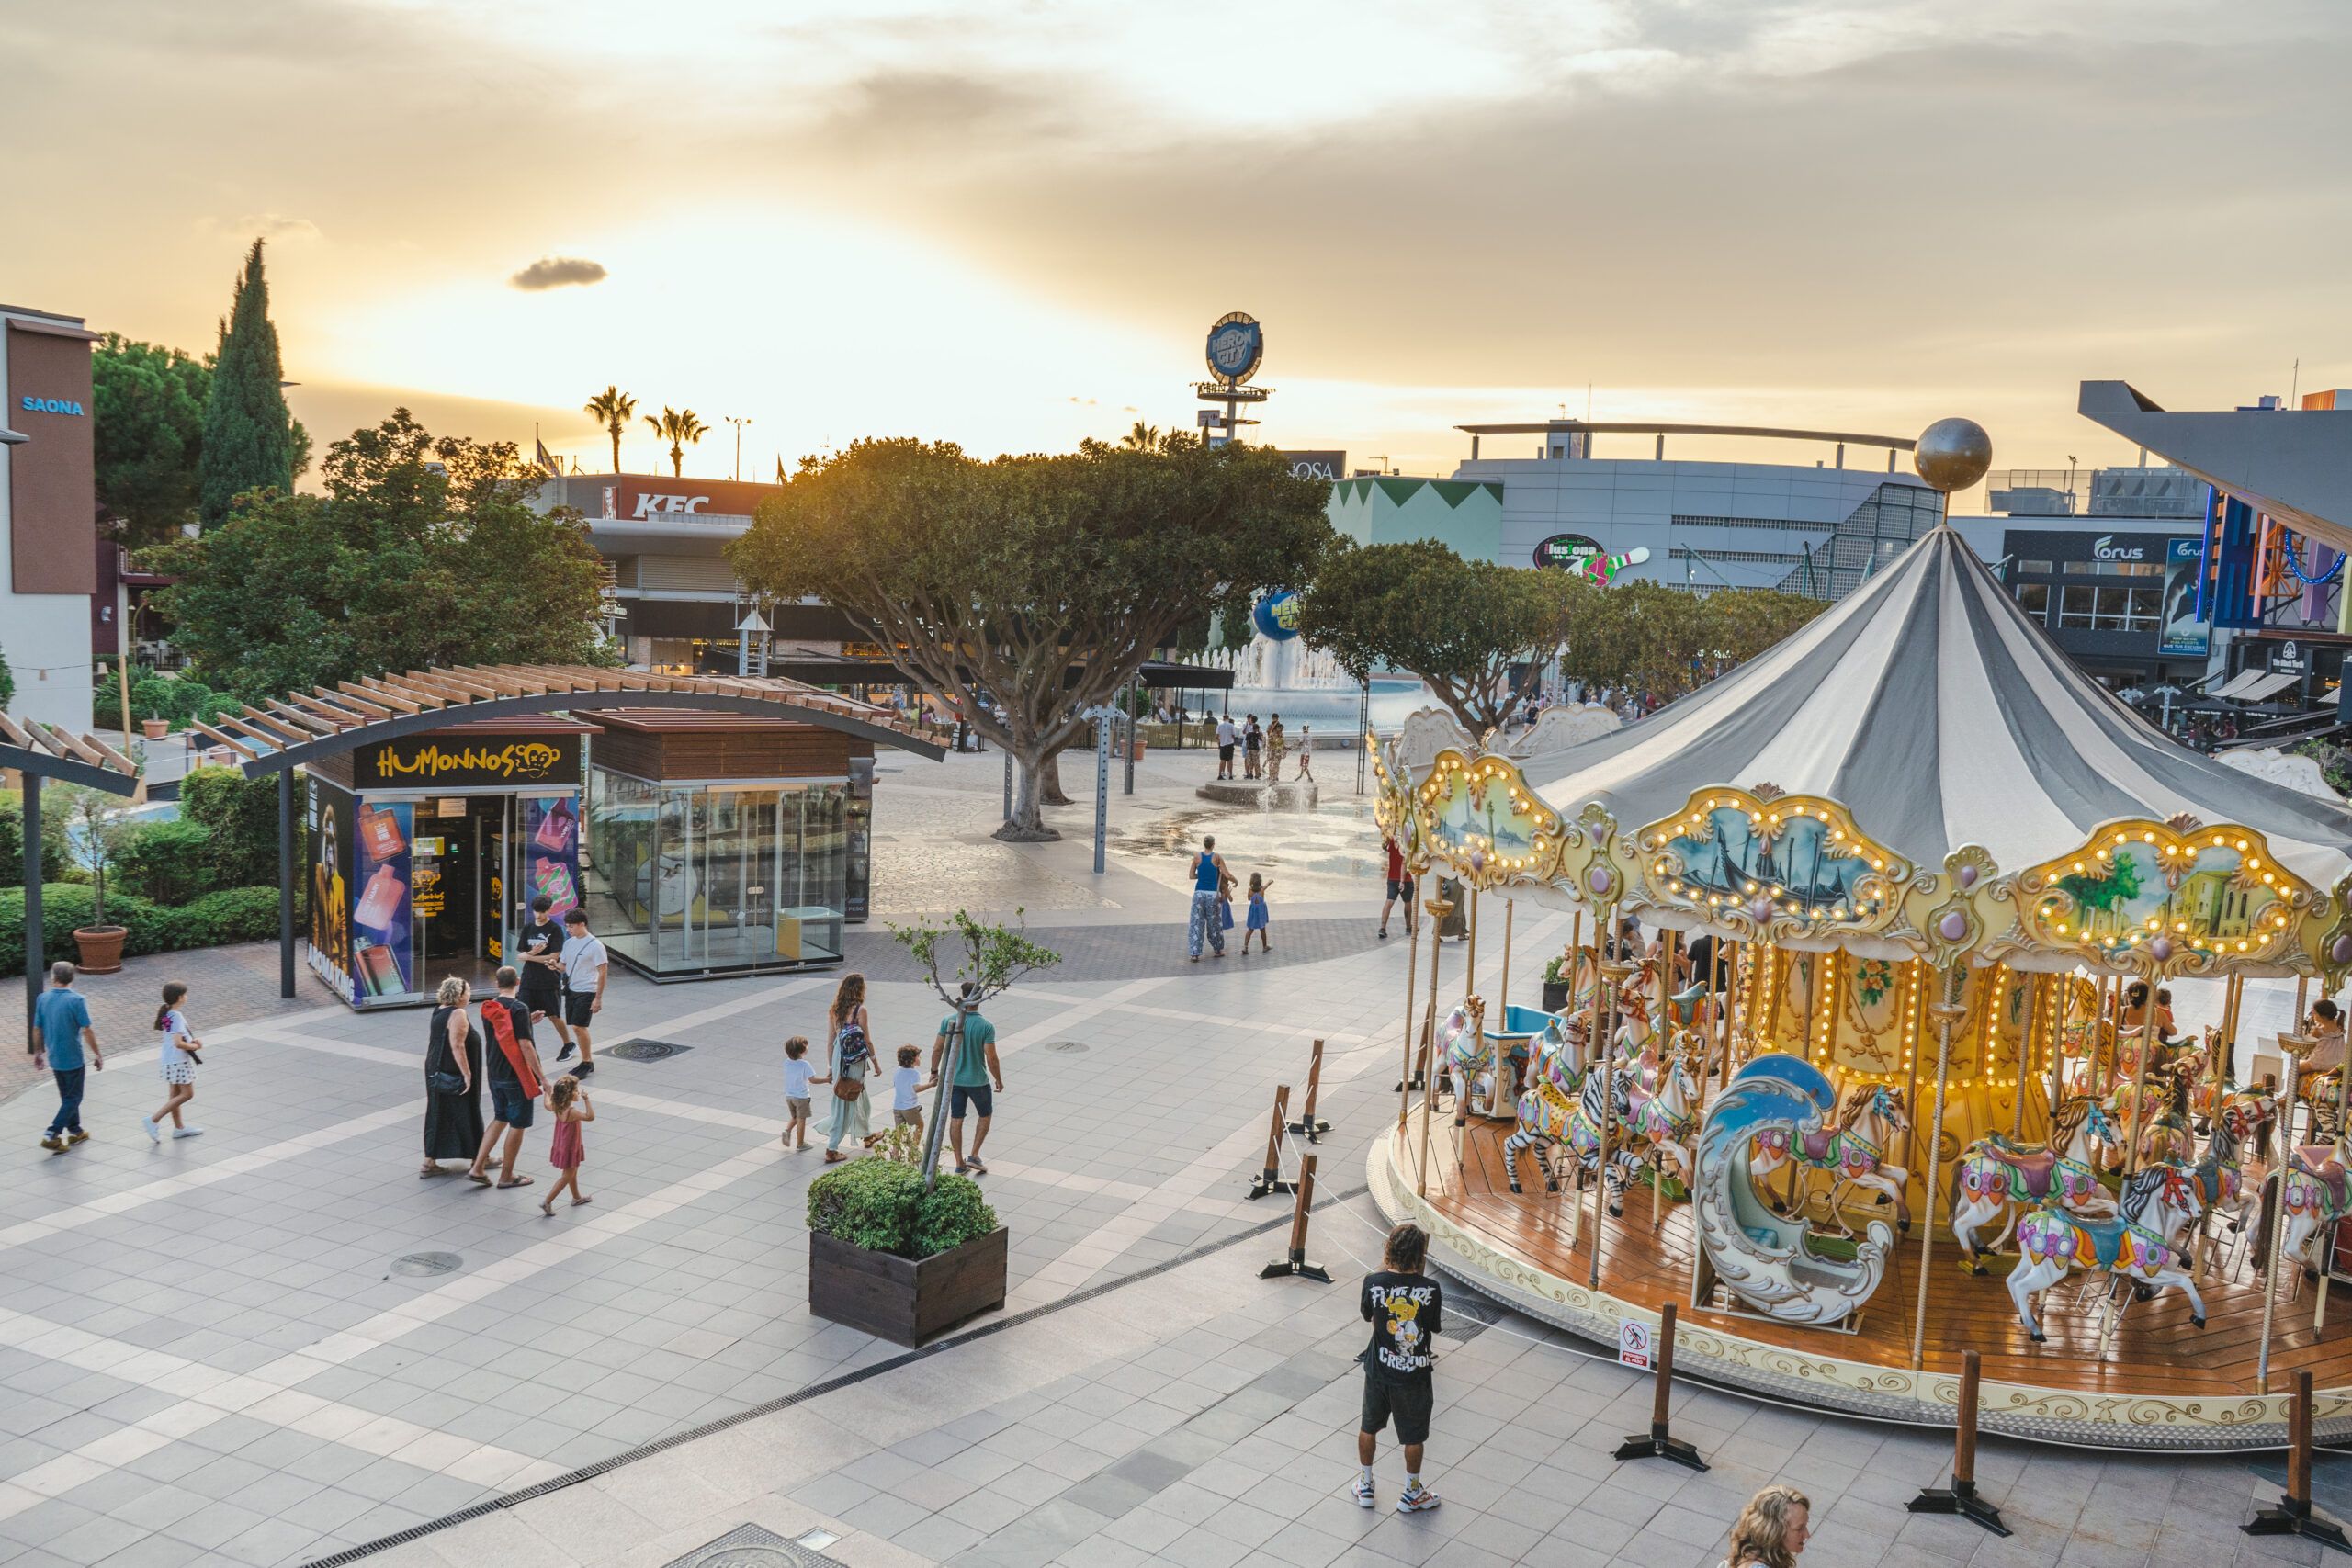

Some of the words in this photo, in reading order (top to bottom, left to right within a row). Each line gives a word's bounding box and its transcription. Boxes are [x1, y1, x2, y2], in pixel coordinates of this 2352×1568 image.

[1212, 329, 1252, 353] HERON
[1217, 347, 1246, 366] CITY
[22, 396, 85, 416] SAONA
[632, 493, 710, 518] KFC
